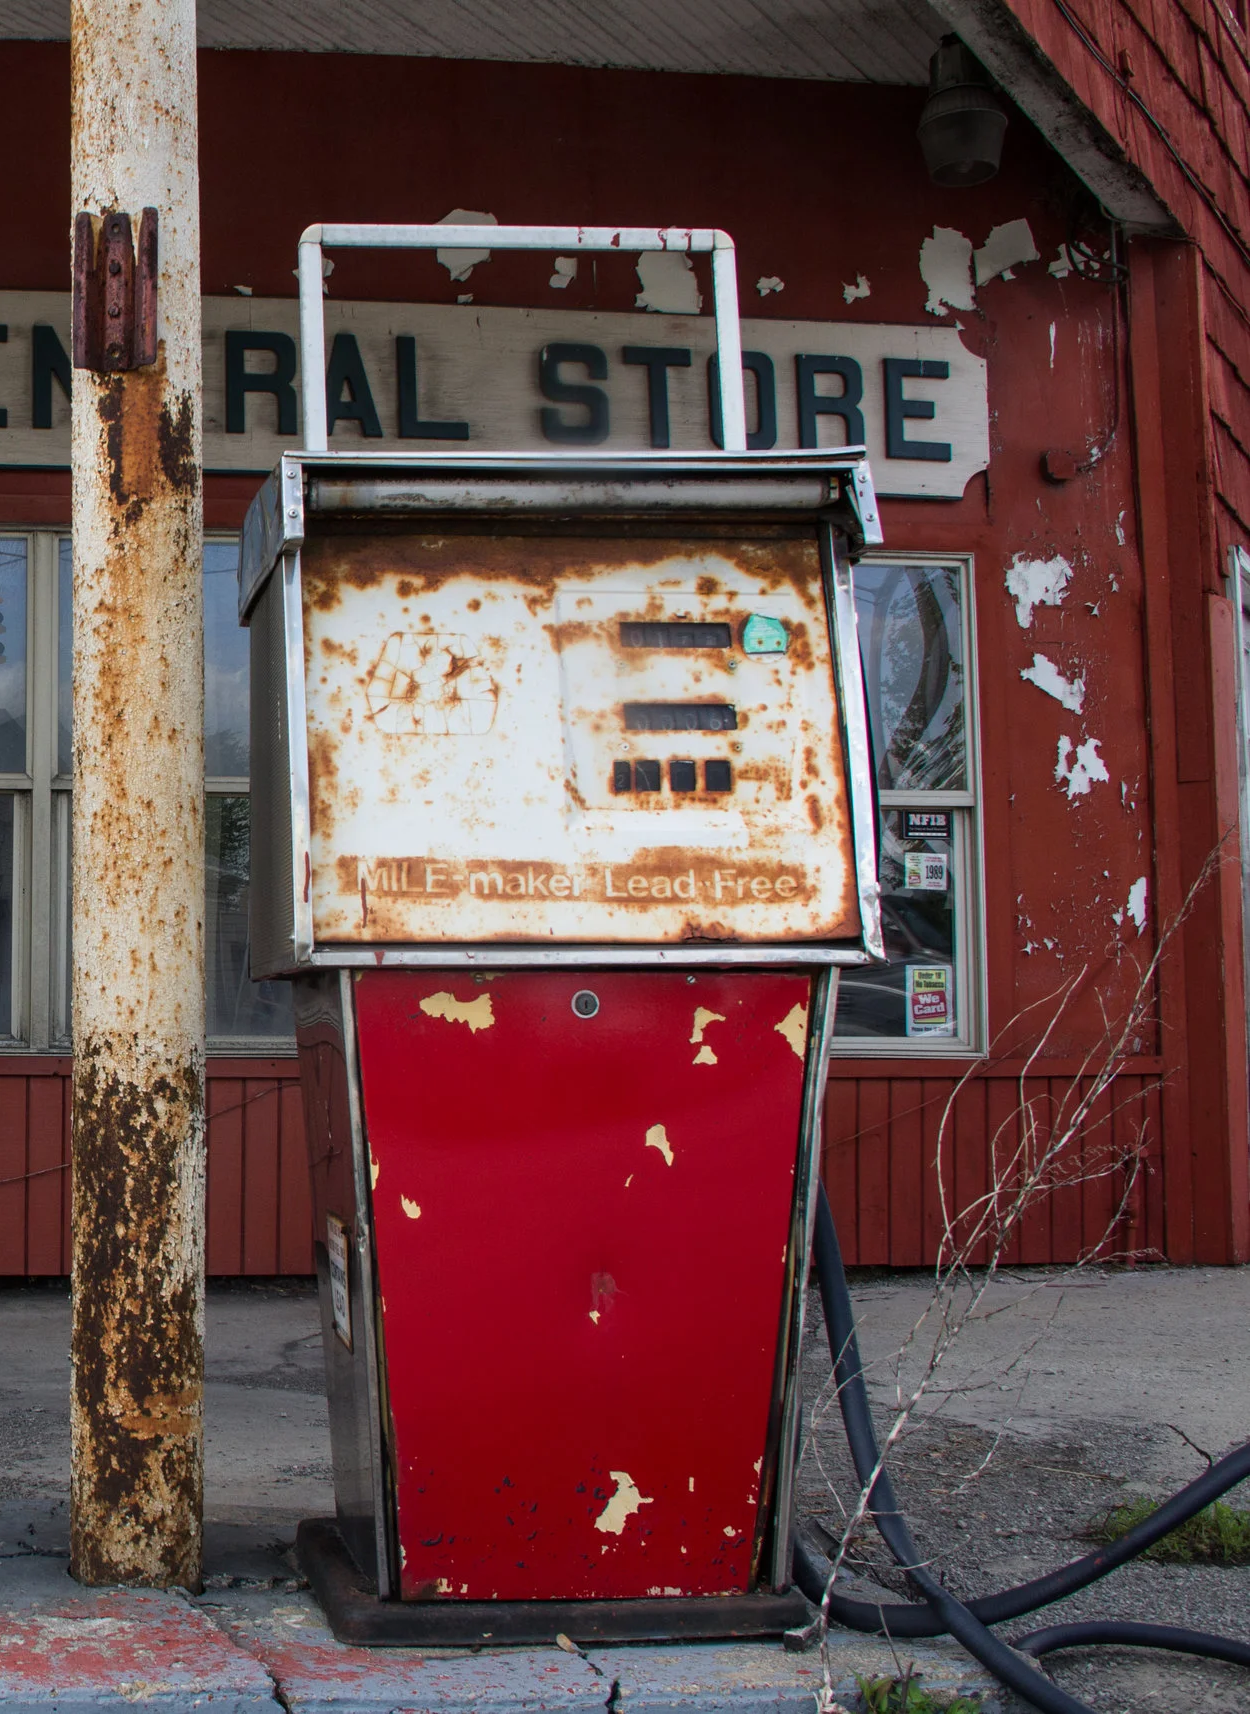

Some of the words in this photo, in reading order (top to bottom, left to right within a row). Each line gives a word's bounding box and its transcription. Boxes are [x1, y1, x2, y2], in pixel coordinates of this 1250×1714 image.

[538, 341, 952, 462] STORE
[908, 813, 946, 826] NFIB
[925, 864, 943, 880] 1989
[918, 993, 940, 1004] We
[913, 1002, 946, 1015] Card
